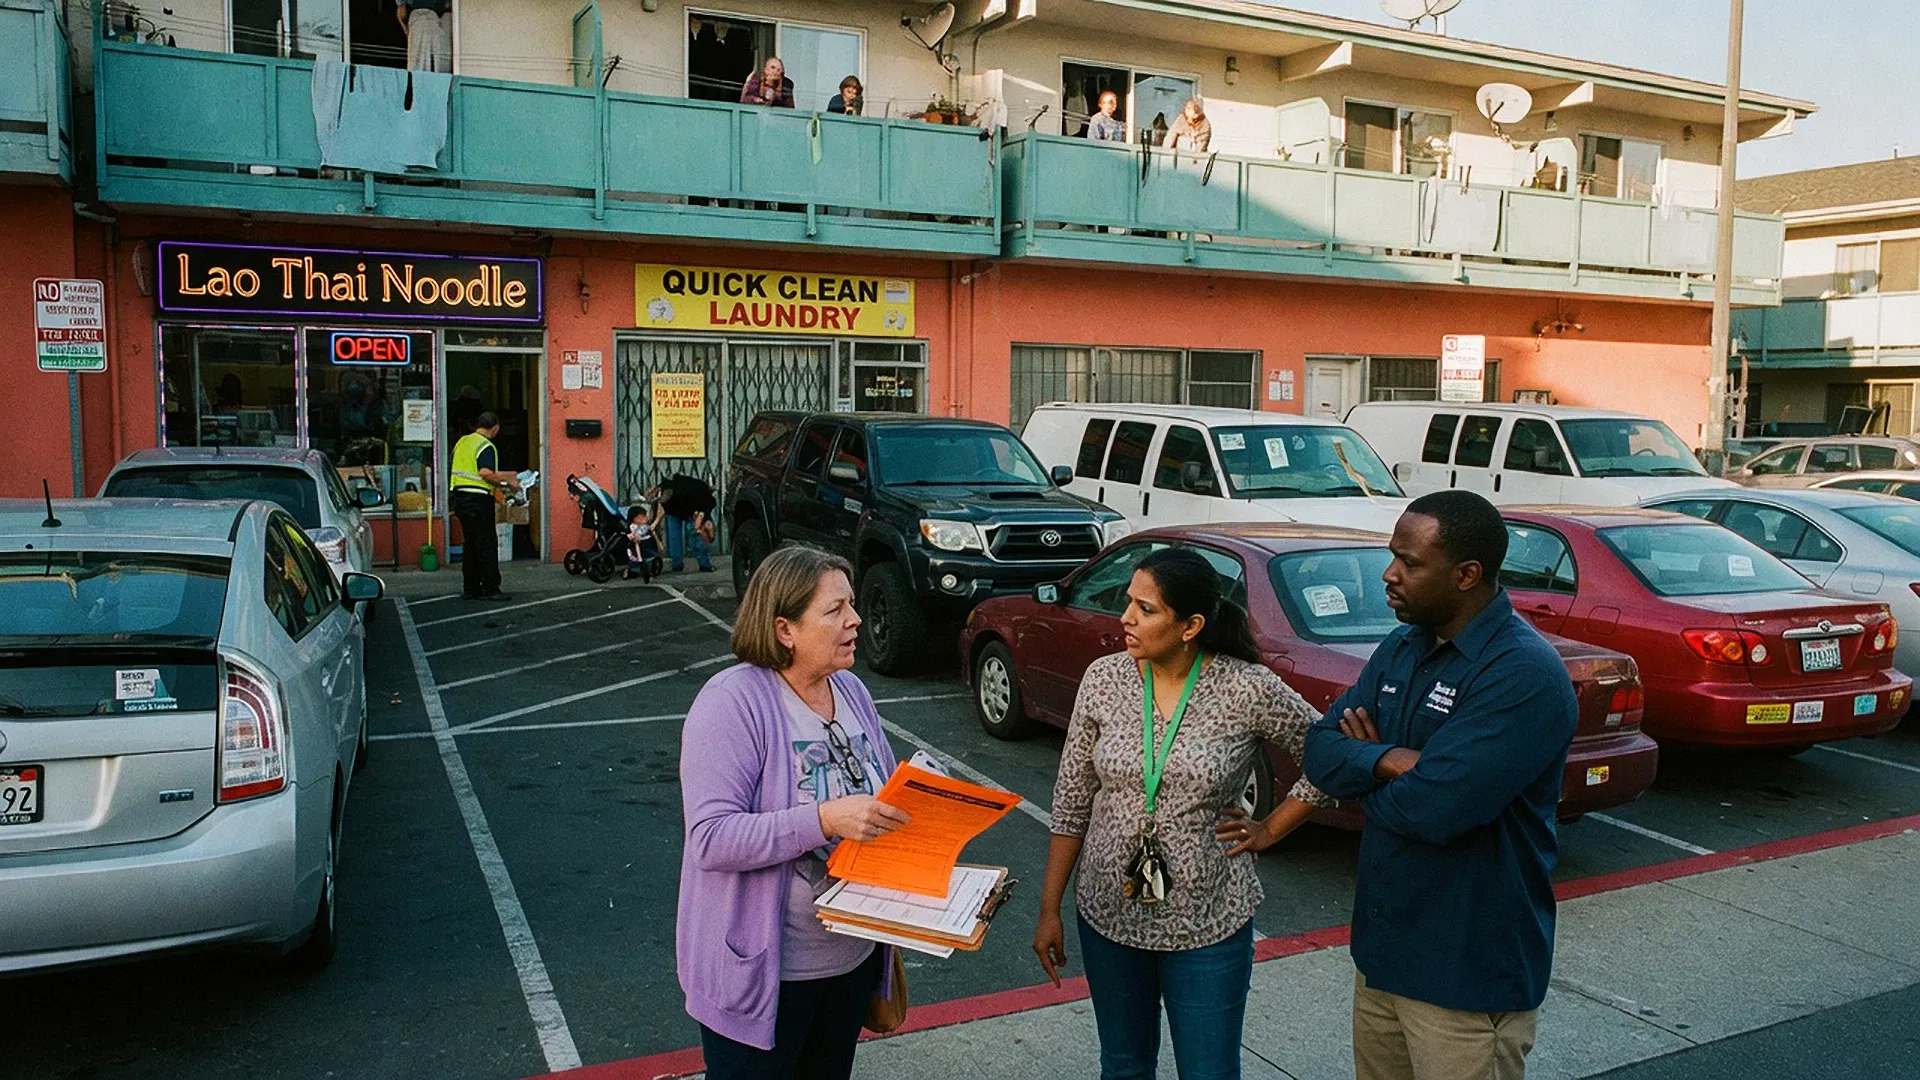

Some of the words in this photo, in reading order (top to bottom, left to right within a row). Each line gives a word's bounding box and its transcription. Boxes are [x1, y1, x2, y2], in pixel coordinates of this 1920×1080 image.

[177, 253, 260, 297] Lao
[271, 256, 368, 302] Thai
[380, 263, 527, 308] Noodle
[662, 269, 767, 298] QUICK
[777, 275, 878, 303] CLEAN
[709, 300, 861, 330] LAUNDRY
[335, 337, 406, 360] OPEN
